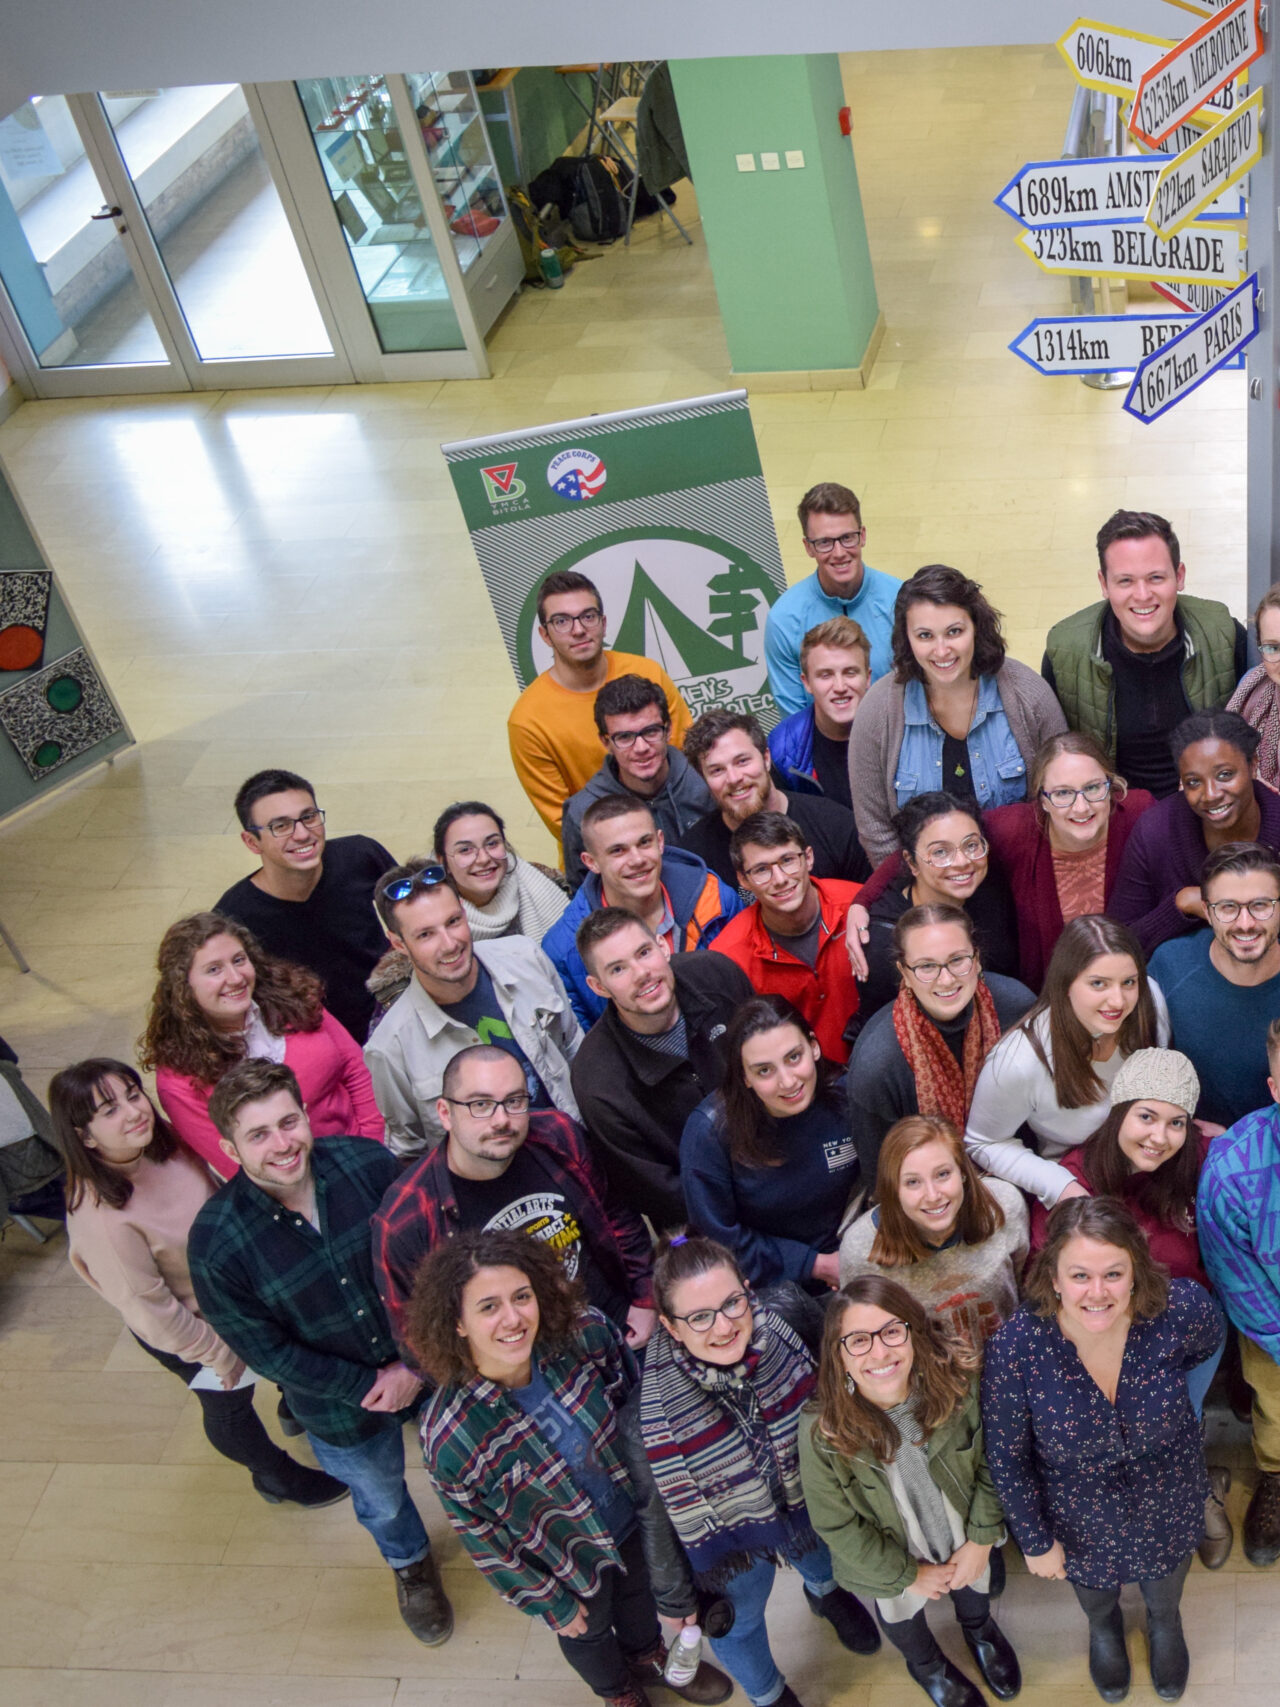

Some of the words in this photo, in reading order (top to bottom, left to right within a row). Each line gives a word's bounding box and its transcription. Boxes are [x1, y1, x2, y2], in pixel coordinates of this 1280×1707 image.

[1077, 32, 1132, 83] 606km
[1138, 72, 1190, 135] 15253km
[1190, 10, 1249, 94] MELBOURNE
[1156, 170, 1196, 230] 322km
[1201, 110, 1252, 188] SARAJEVO
[1015, 176, 1099, 218] 1689km
[1033, 227, 1103, 264] 323km
[1113, 230, 1225, 274] BELGRADE
[1035, 329, 1110, 363] 1314km
[1139, 353, 1199, 415] 1667km
[1204, 302, 1243, 366] PARIS
[551, 450, 571, 470] PEACE
[572, 450, 597, 463] CORPS
[490, 498, 530, 509] YMCA
[492, 504, 532, 516] BITOLA
[823, 1140, 838, 1148] NEW
[525, 1198, 555, 1215] ARTS
